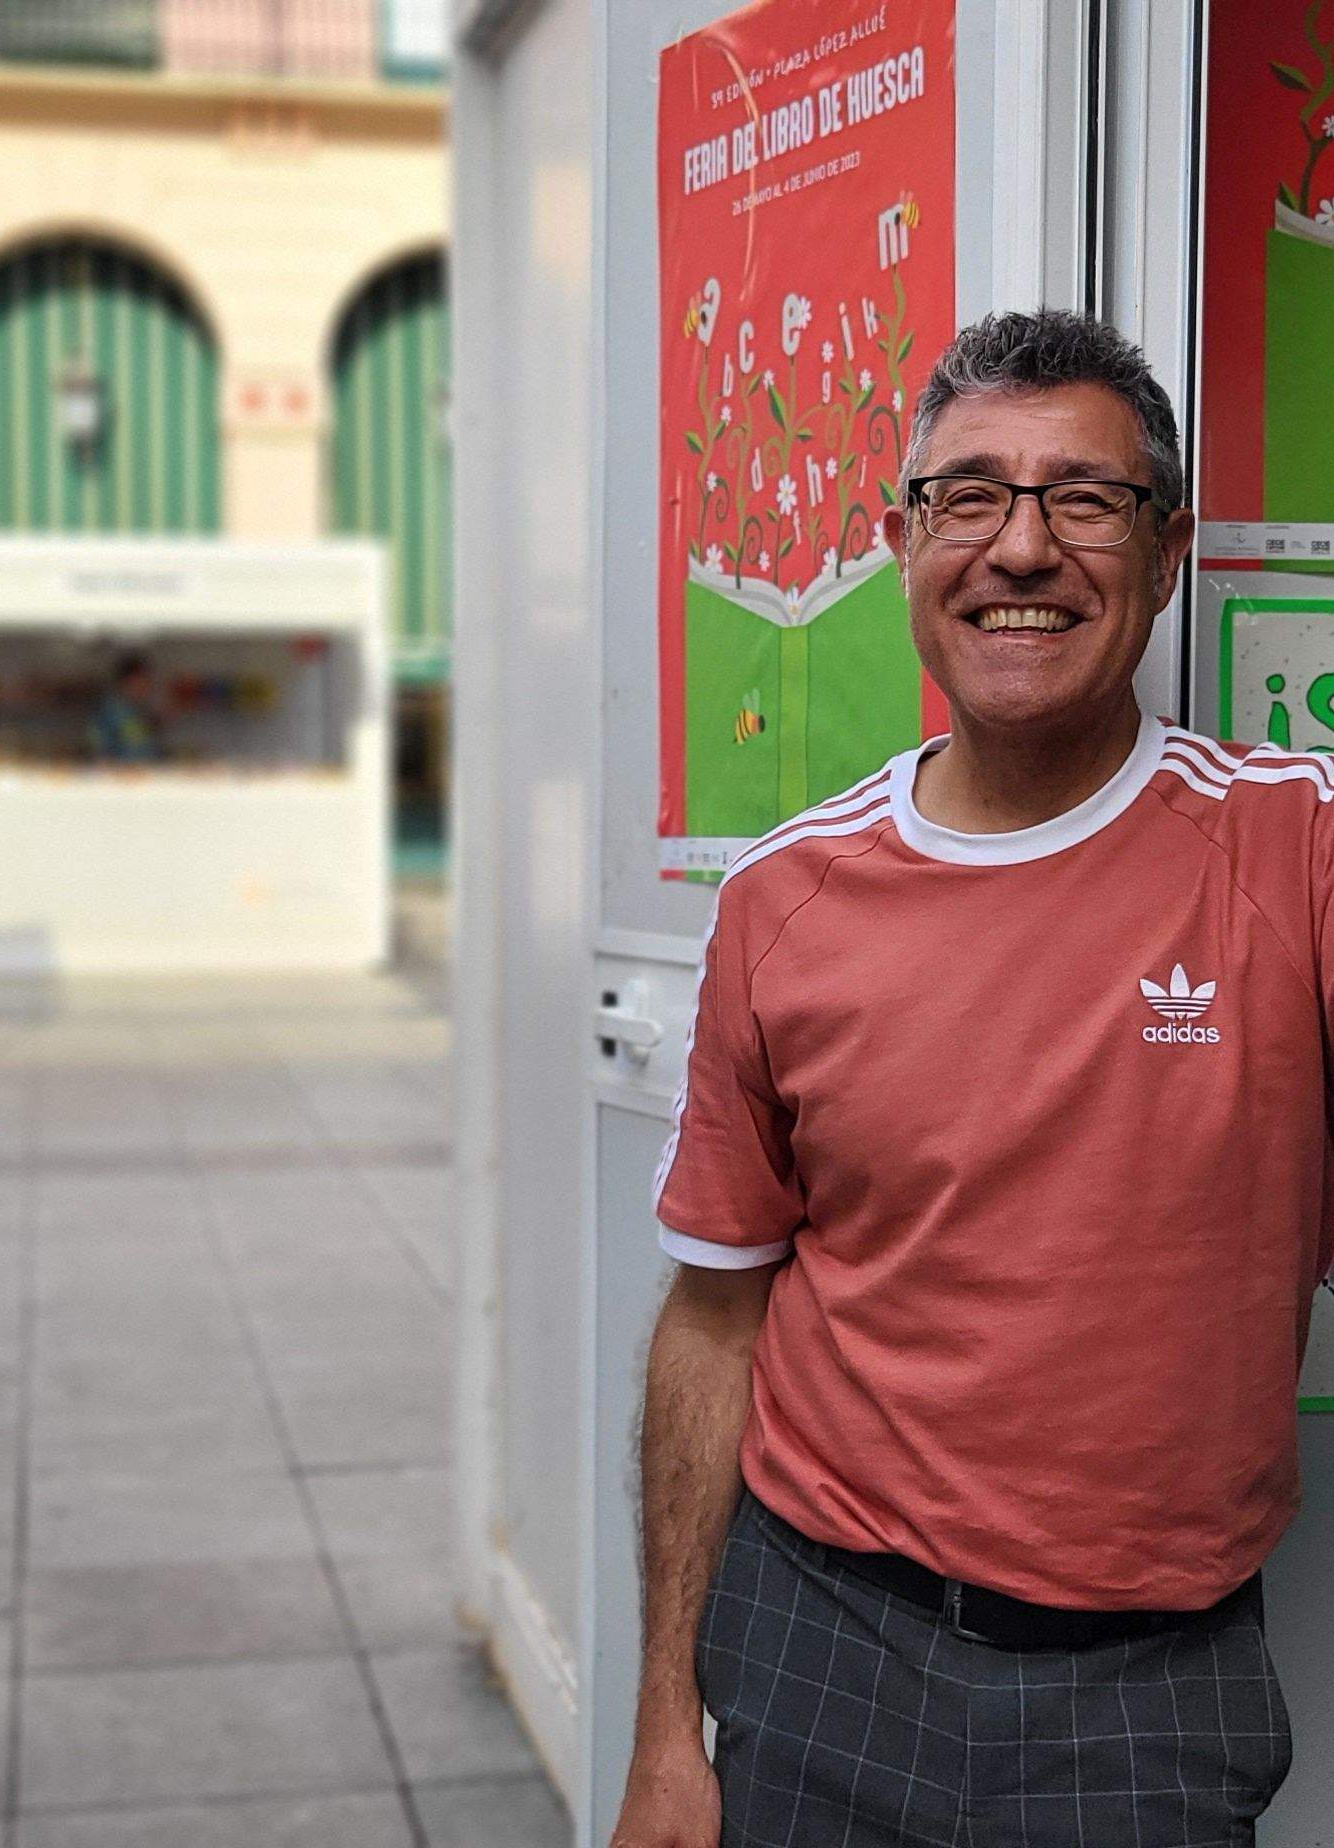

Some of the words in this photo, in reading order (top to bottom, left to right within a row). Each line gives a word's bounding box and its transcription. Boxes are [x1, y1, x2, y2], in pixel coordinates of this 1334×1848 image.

[774, 49, 810, 79] PLAZA
[813, 31, 848, 61] LÓPEZ
[850, 5, 887, 47] ALLUÉ
[684, 134, 727, 195] FERIA
[762, 95, 814, 161] LIBRO
[819, 82, 843, 138] DE
[847, 46, 924, 126] HUESCA
[772, 182, 784, 199] AL
[790, 174, 802, 192] DE
[803, 164, 825, 188] JUNIO
[827, 159, 840, 177] DE
[878, 204, 908, 271] m
[781, 293, 802, 356] e
[861, 297, 878, 340] k
[722, 353, 734, 397] b
[822, 371, 831, 404] g
[751, 446, 763, 492] d
[806, 454, 823, 507] h
[1142, 1022, 1221, 1044] adidas
